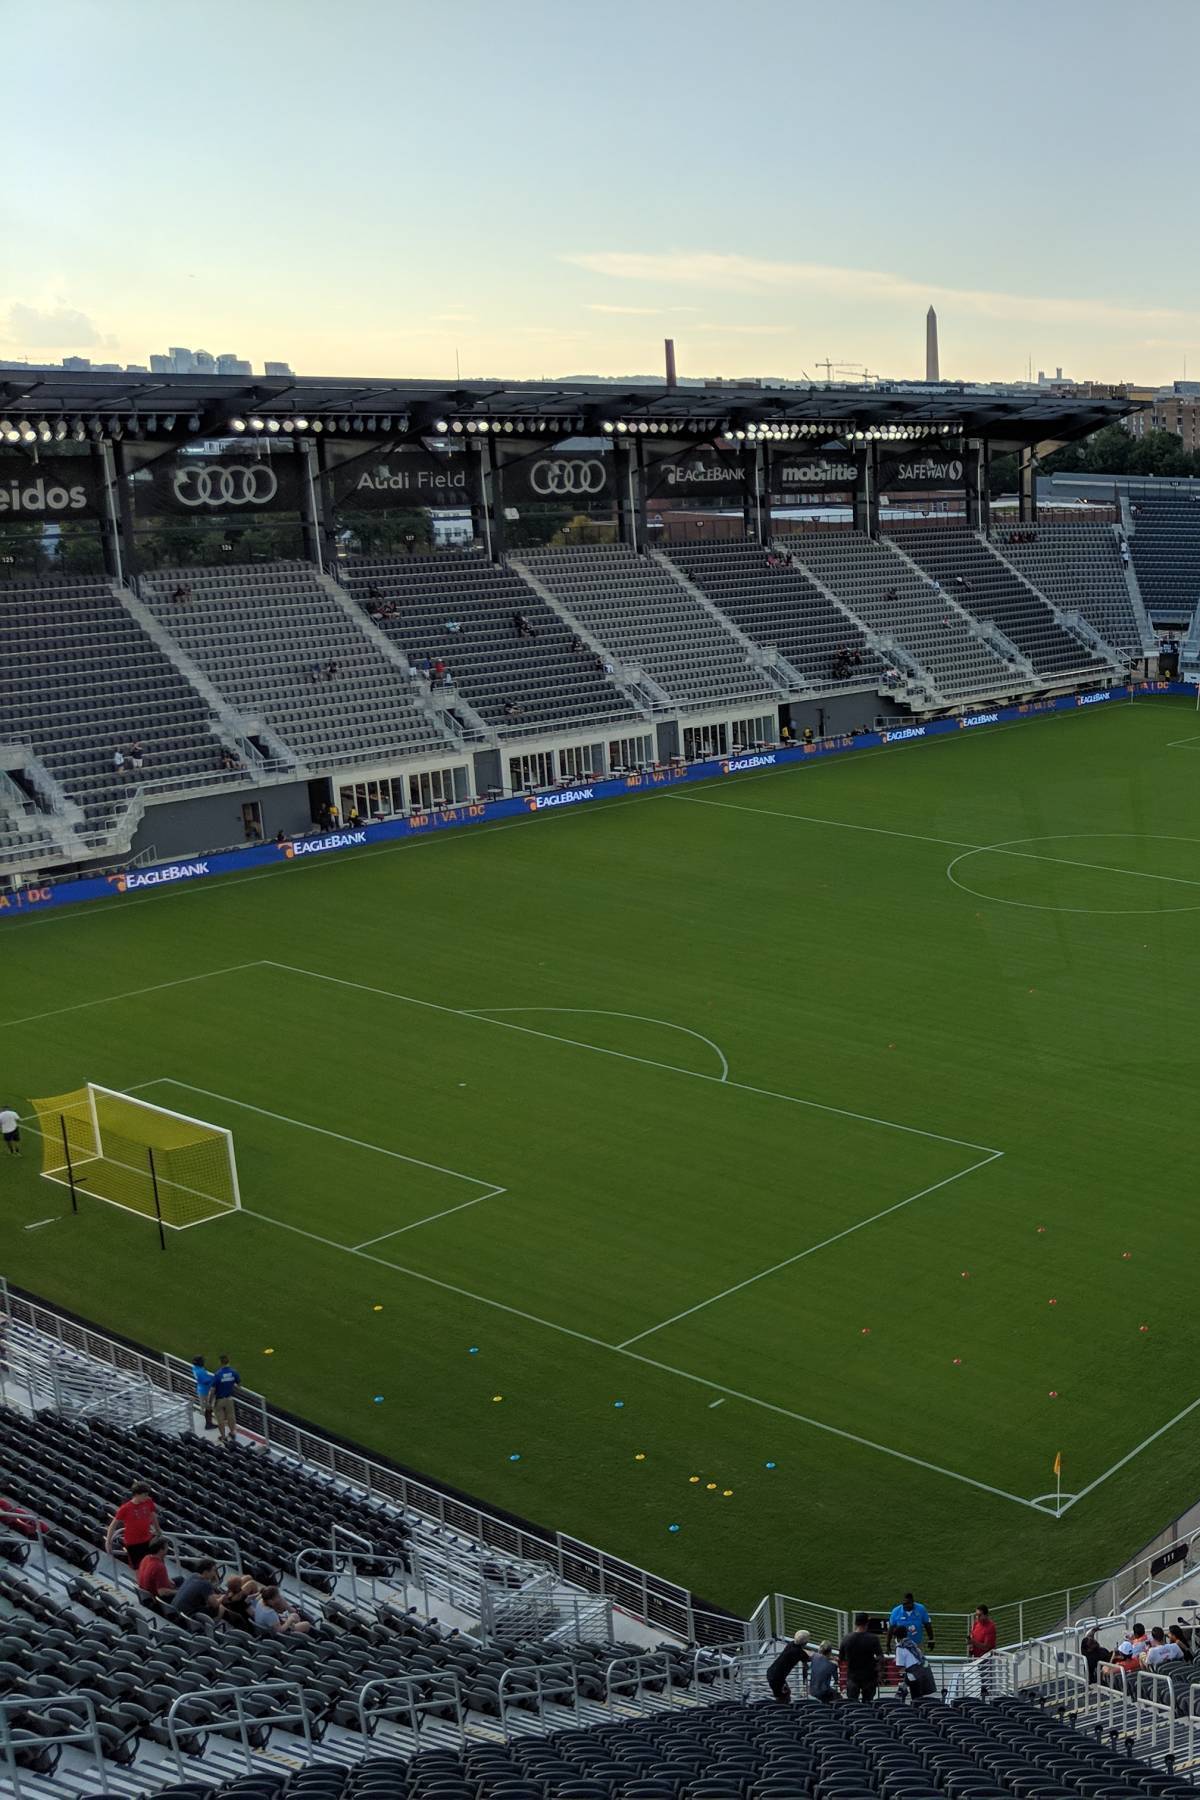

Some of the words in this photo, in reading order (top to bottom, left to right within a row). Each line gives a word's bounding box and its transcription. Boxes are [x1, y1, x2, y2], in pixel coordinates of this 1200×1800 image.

[357, 472, 409, 490] Audi
[418, 470, 465, 488] Field
[898, 462, 949, 481] SAFEWAY
[536, 788, 594, 809] EAGLEBANK
[409, 815, 428, 829] MD
[441, 810, 457, 822] VA
[469, 805, 486, 817] DC
[293, 831, 367, 855] EAGLEBANK
[126, 862, 210, 889] EAGLEBANK
[27, 887, 52, 903] DC
